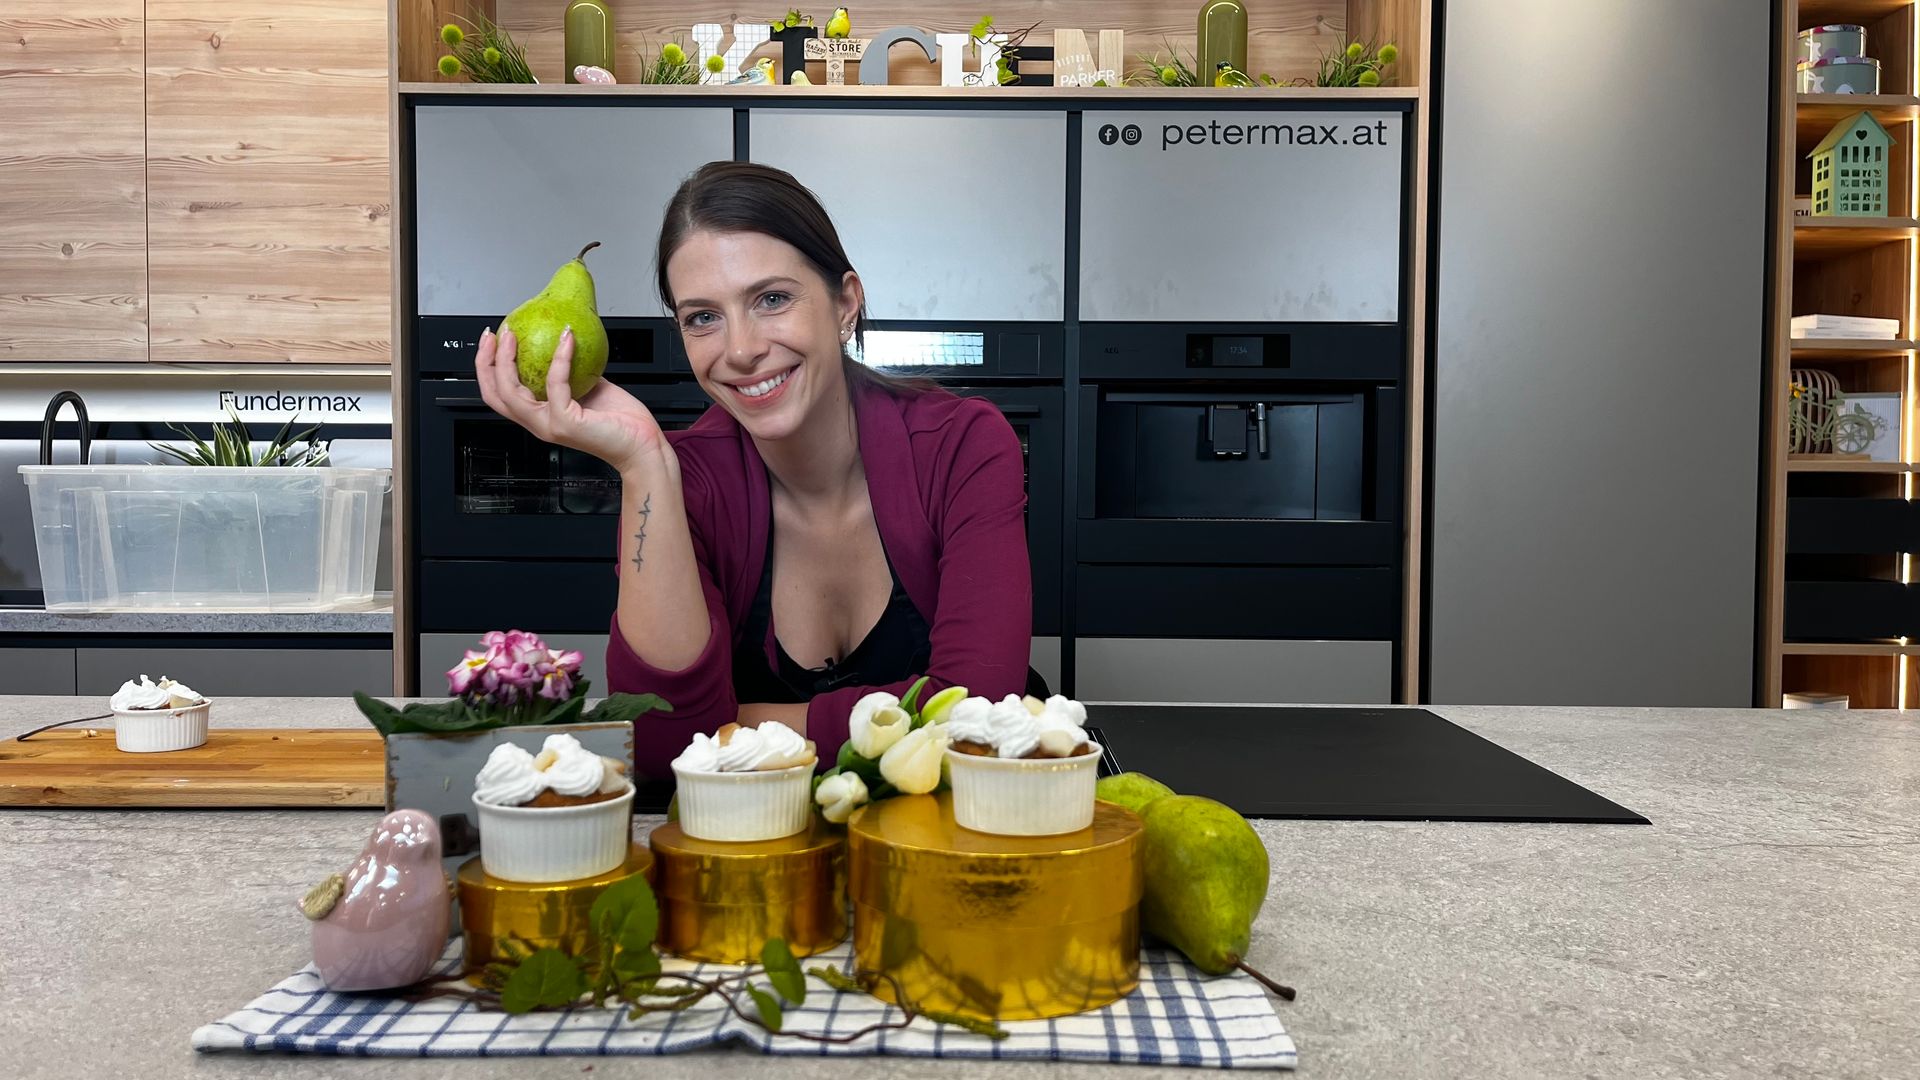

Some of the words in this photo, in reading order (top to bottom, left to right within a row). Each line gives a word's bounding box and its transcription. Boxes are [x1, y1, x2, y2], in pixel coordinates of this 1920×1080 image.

[829, 43, 861, 53] STORE
[1060, 69, 1116, 87] PARKER
[1162, 119, 1388, 151] petermax.at
[219, 390, 361, 412] Fundermax
